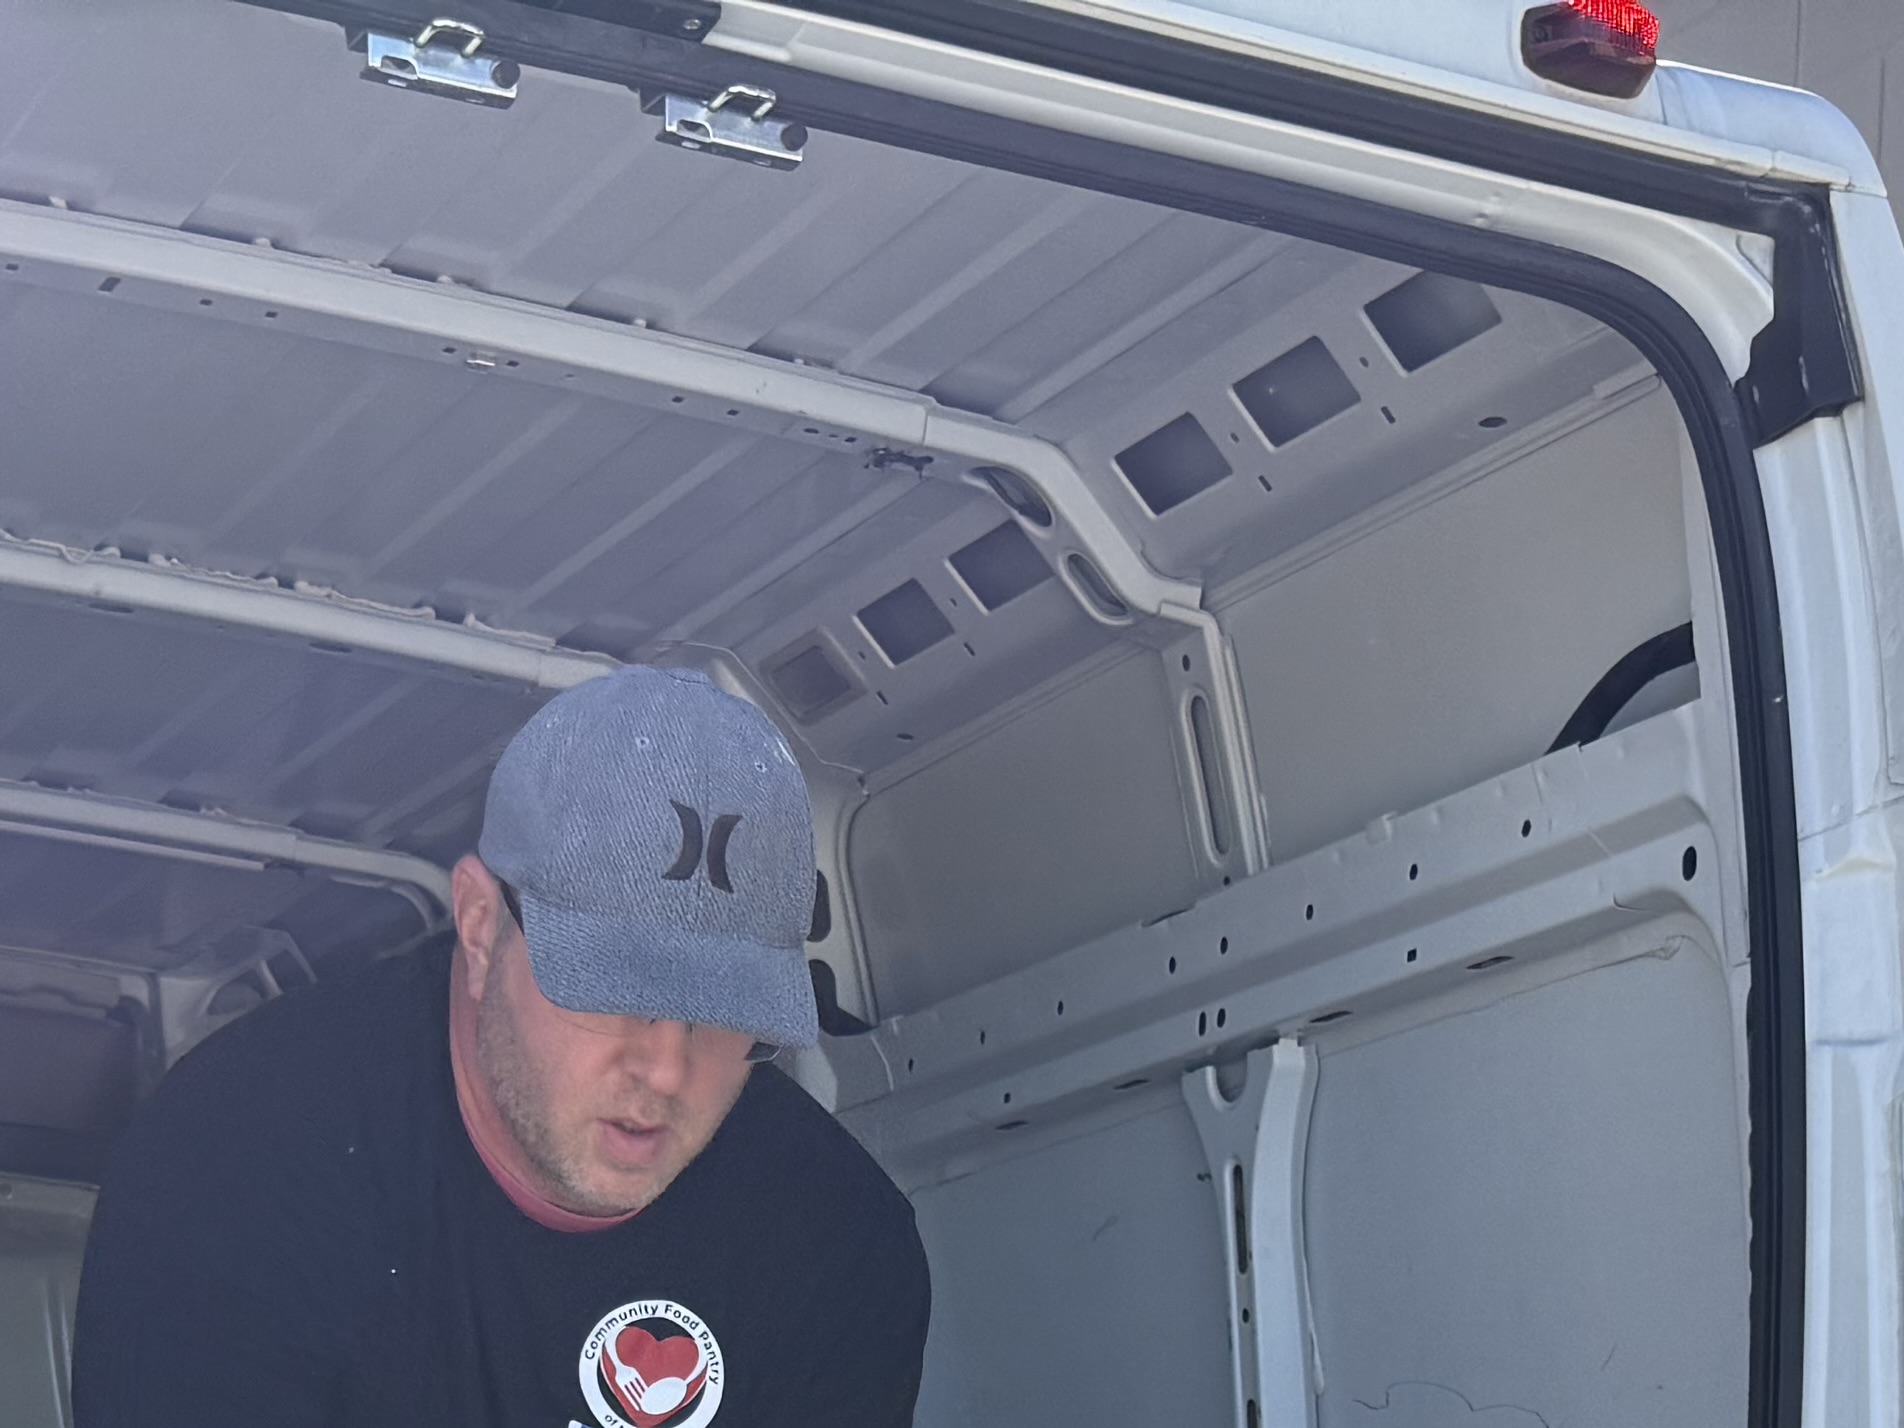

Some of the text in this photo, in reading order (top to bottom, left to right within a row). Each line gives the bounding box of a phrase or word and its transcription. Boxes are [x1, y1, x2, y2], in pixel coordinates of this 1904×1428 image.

[585, 1303, 720, 1386] Community Food Pantry
[604, 1414, 616, 1427] of
